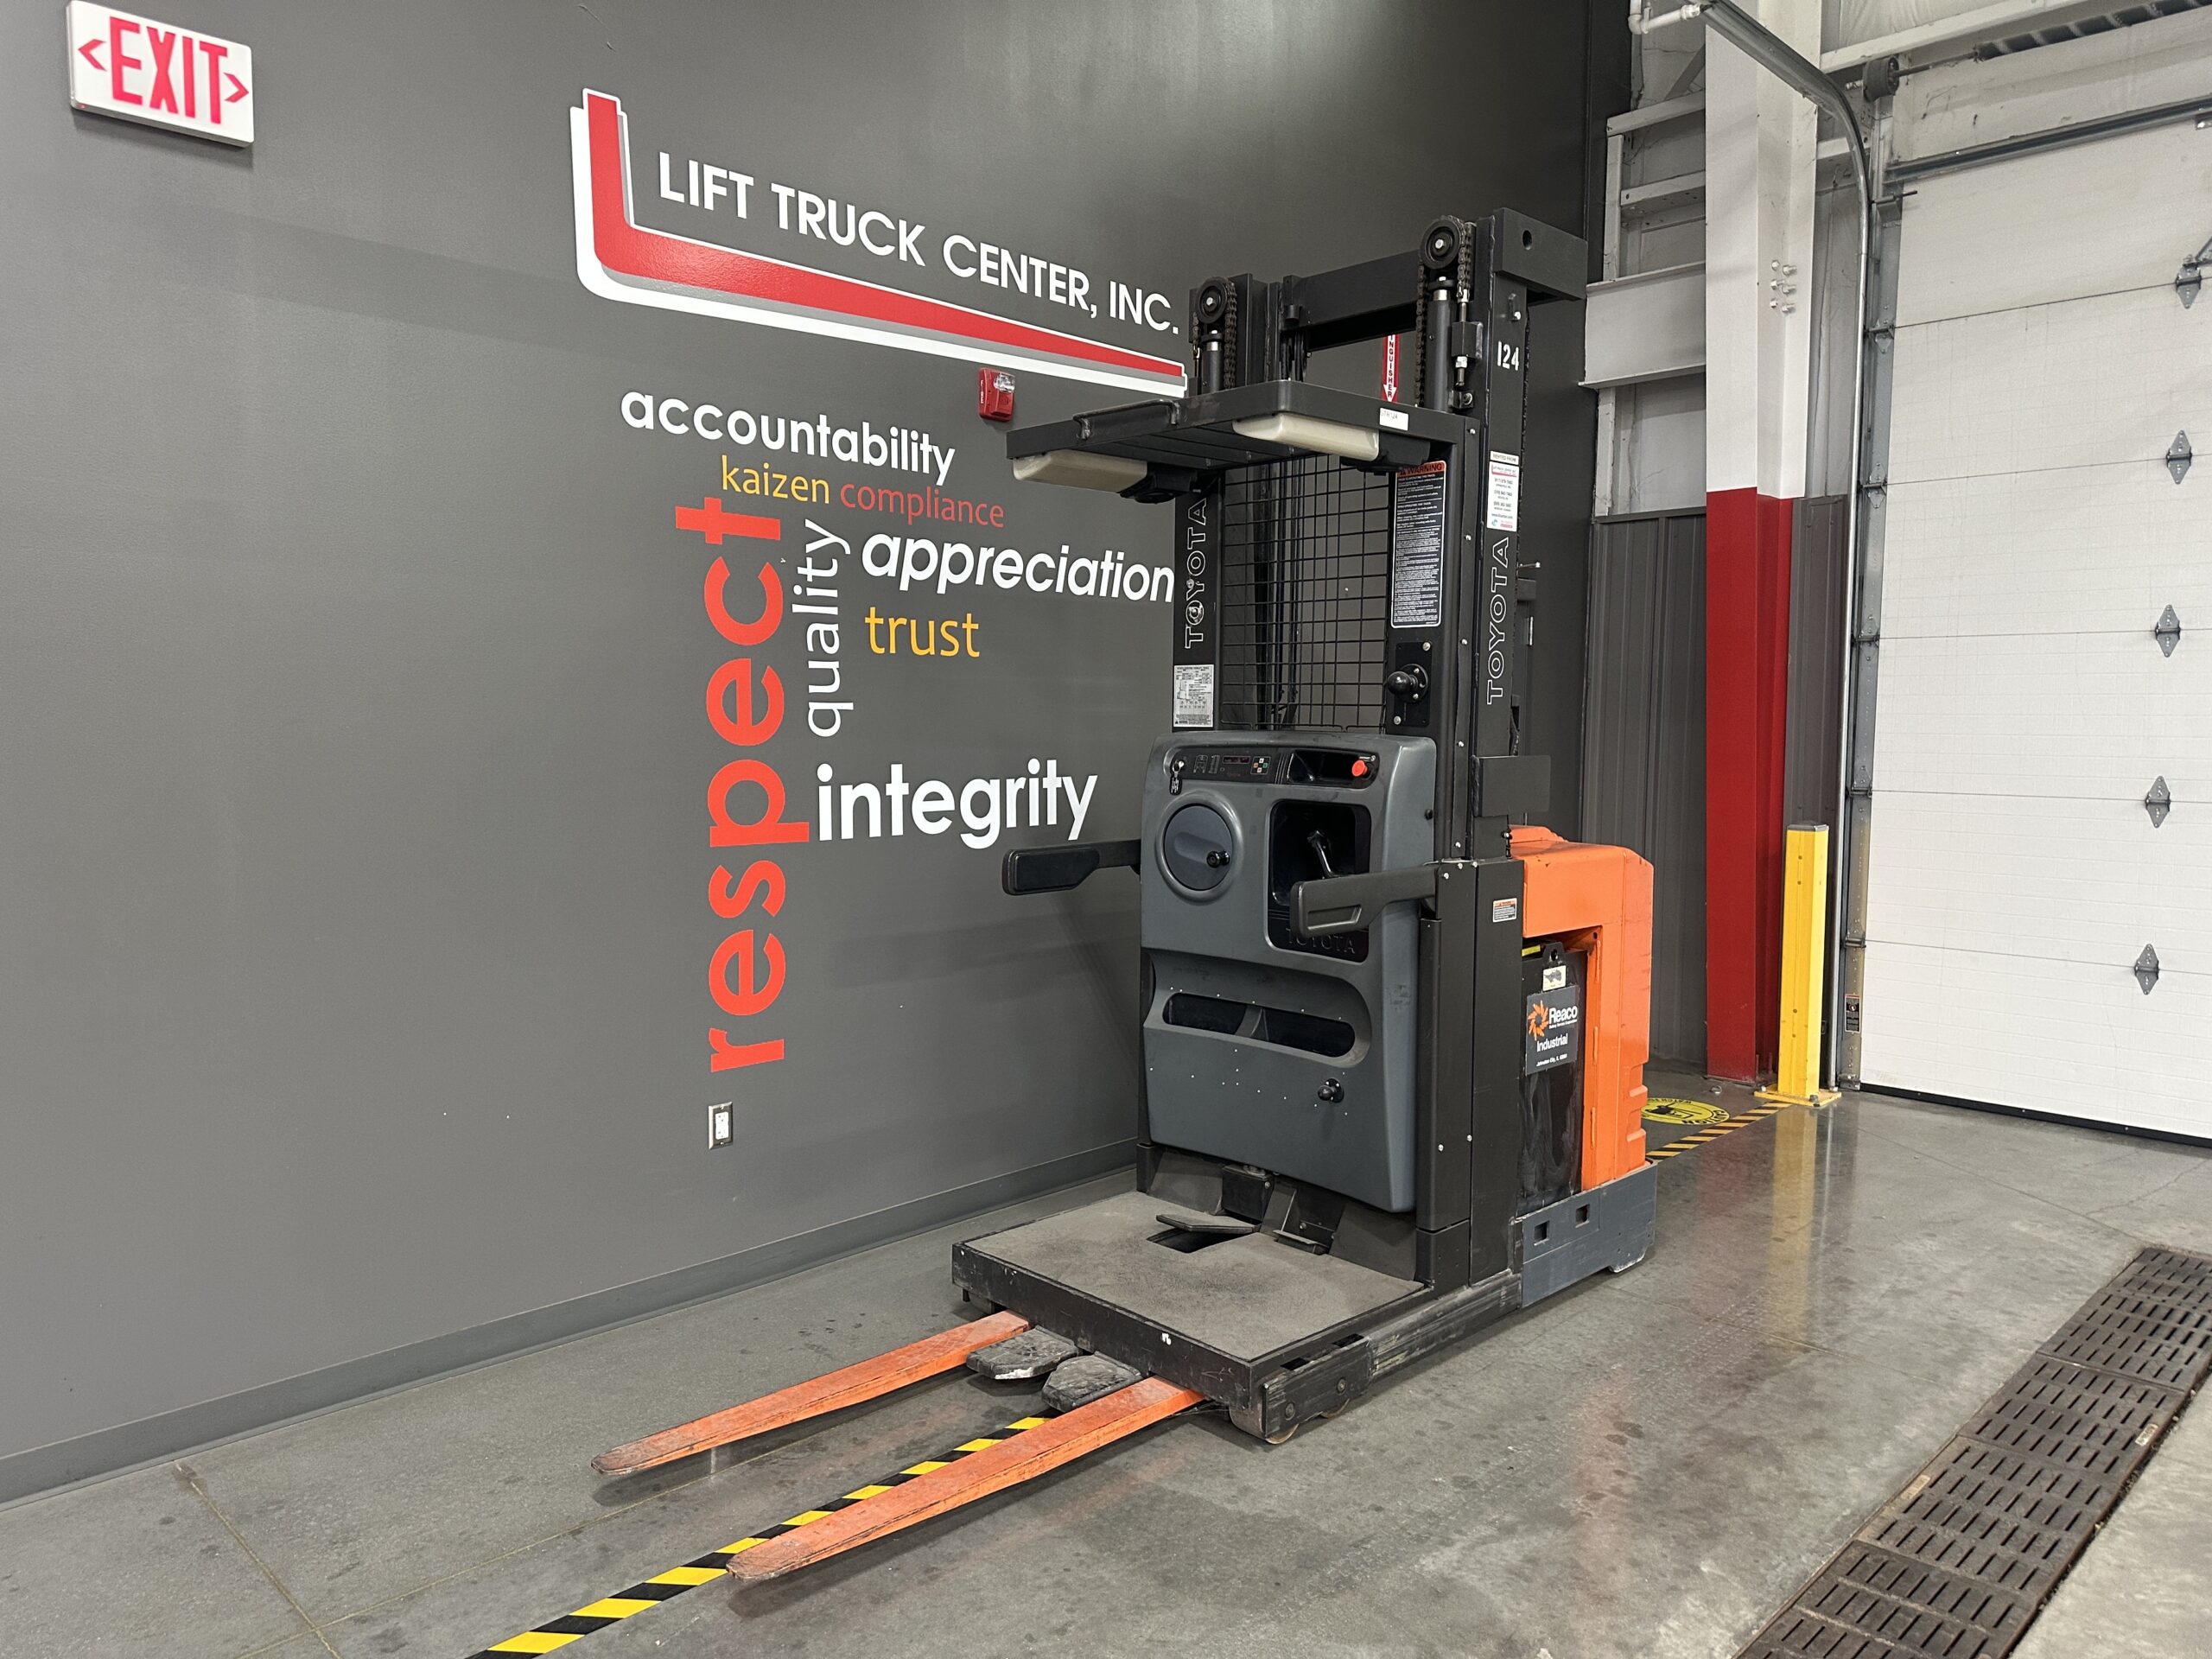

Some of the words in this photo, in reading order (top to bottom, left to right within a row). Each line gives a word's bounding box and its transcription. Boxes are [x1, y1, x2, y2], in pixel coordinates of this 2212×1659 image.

[110, 16, 228, 124] EXIT
[659, 152, 754, 219] LIFT
[771, 183, 926, 266] TRUCK
[943, 235, 1097, 318] CENTER,
[1109, 281, 1179, 334] INC.
[1497, 340, 1519, 372] 124
[620, 391, 956, 486] accountability
[1407, 463, 1442, 474] WARNING
[721, 455, 830, 504] kaizen
[840, 482, 1005, 528] compliance
[861, 533, 1175, 603] appreciation
[1185, 498, 1207, 649] TOYOTA
[791, 518, 855, 737] quality
[864, 607, 980, 658] trust
[1487, 537, 1509, 705] TOYOTA
[675, 497, 810, 1072] respect
[817, 758, 1098, 849] integrity
[1536, 1033, 1568, 1052] Industrial
[1548, 1006, 1578, 1025] Reaco
